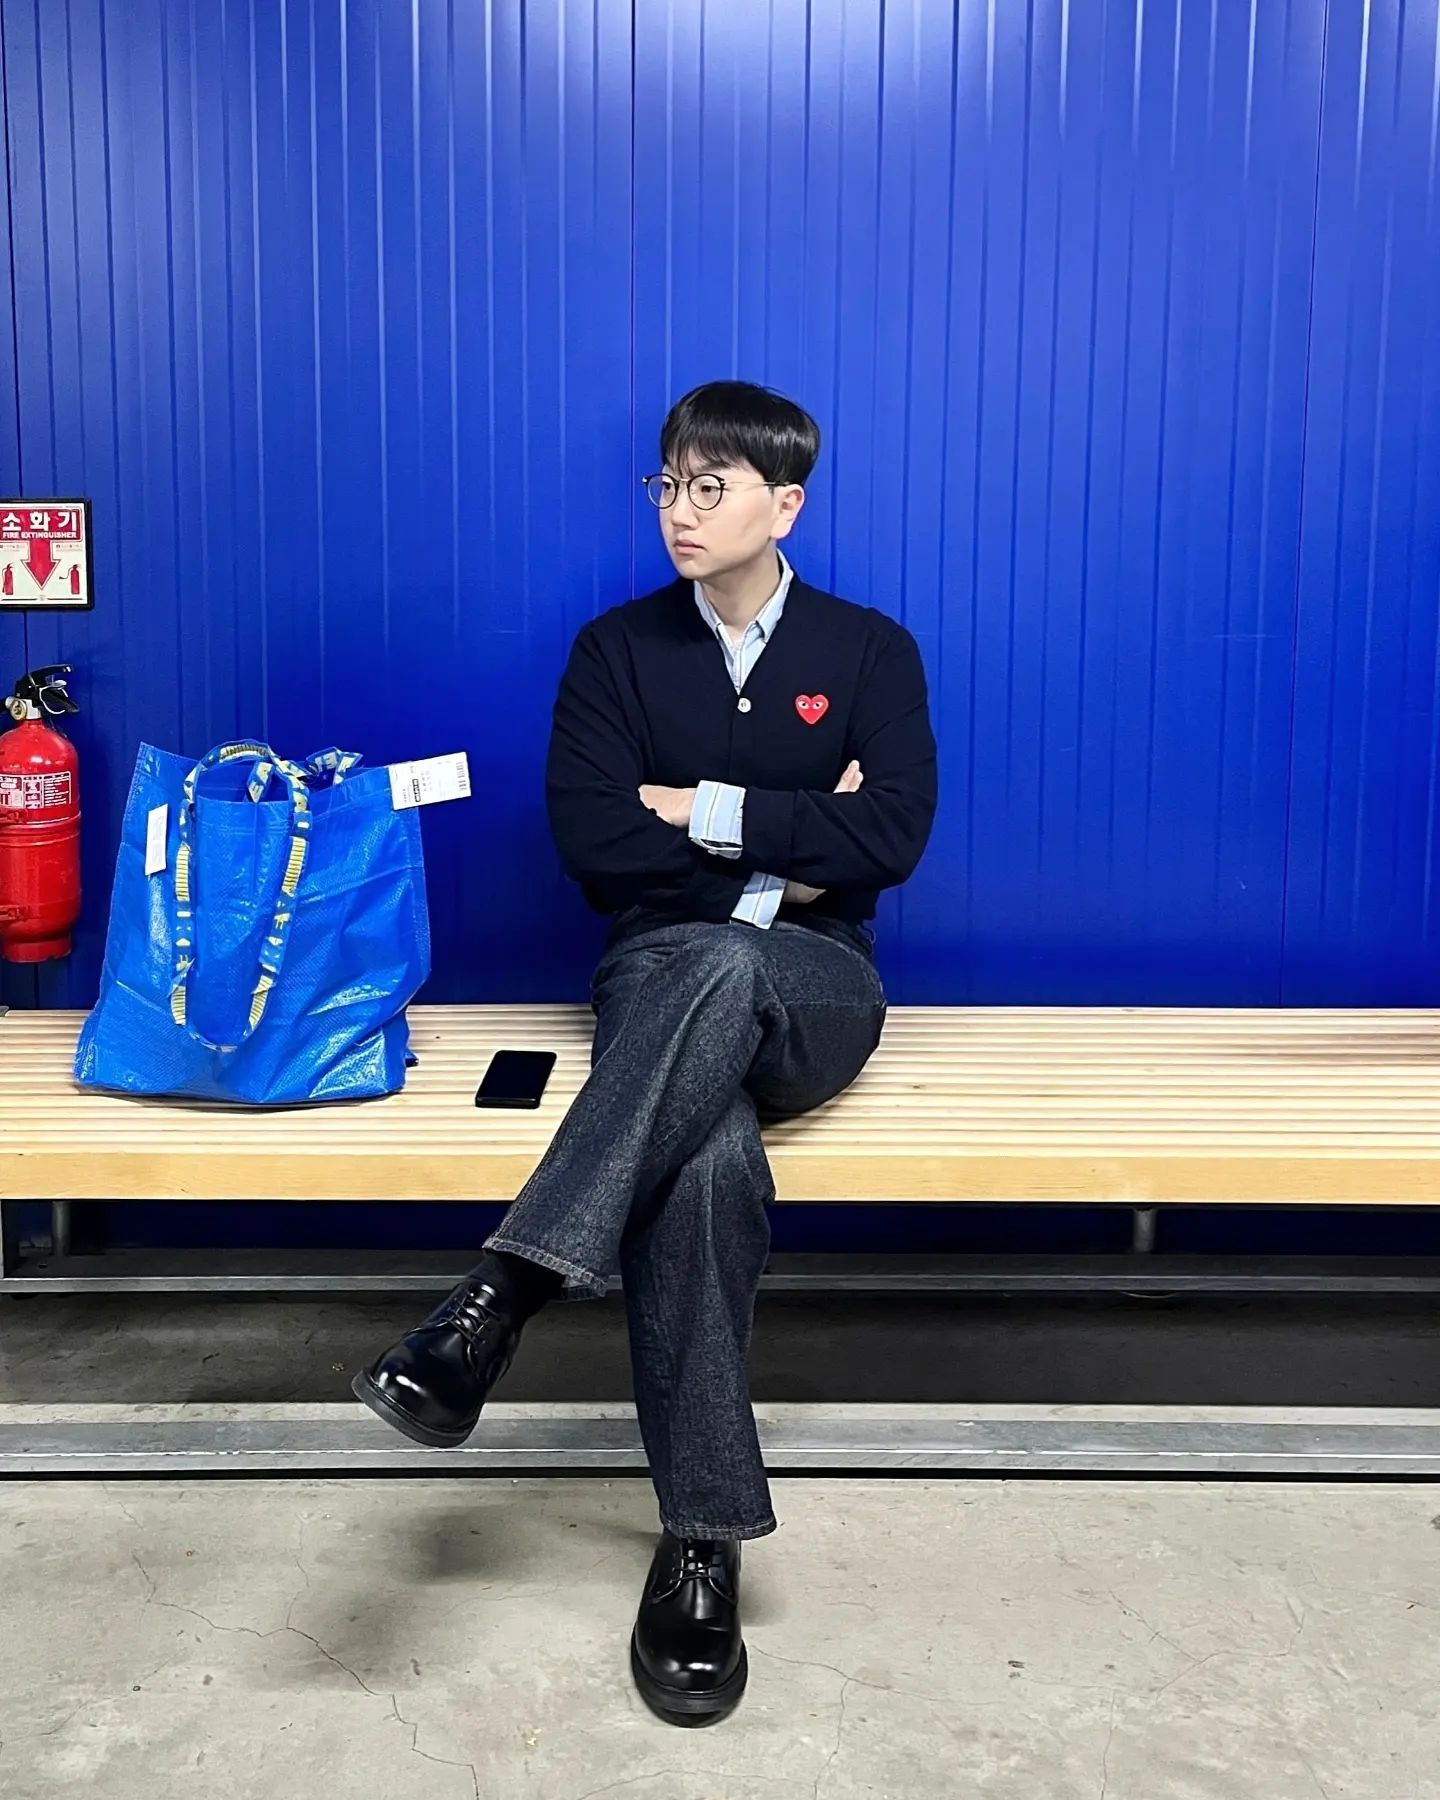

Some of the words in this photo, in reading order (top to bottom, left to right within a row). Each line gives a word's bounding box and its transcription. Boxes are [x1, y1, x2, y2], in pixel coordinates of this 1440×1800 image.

[2, 511, 77, 532] 소화기
[2, 531, 20, 539] FIRE
[21, 531, 77, 539] EXTINGUISHER
